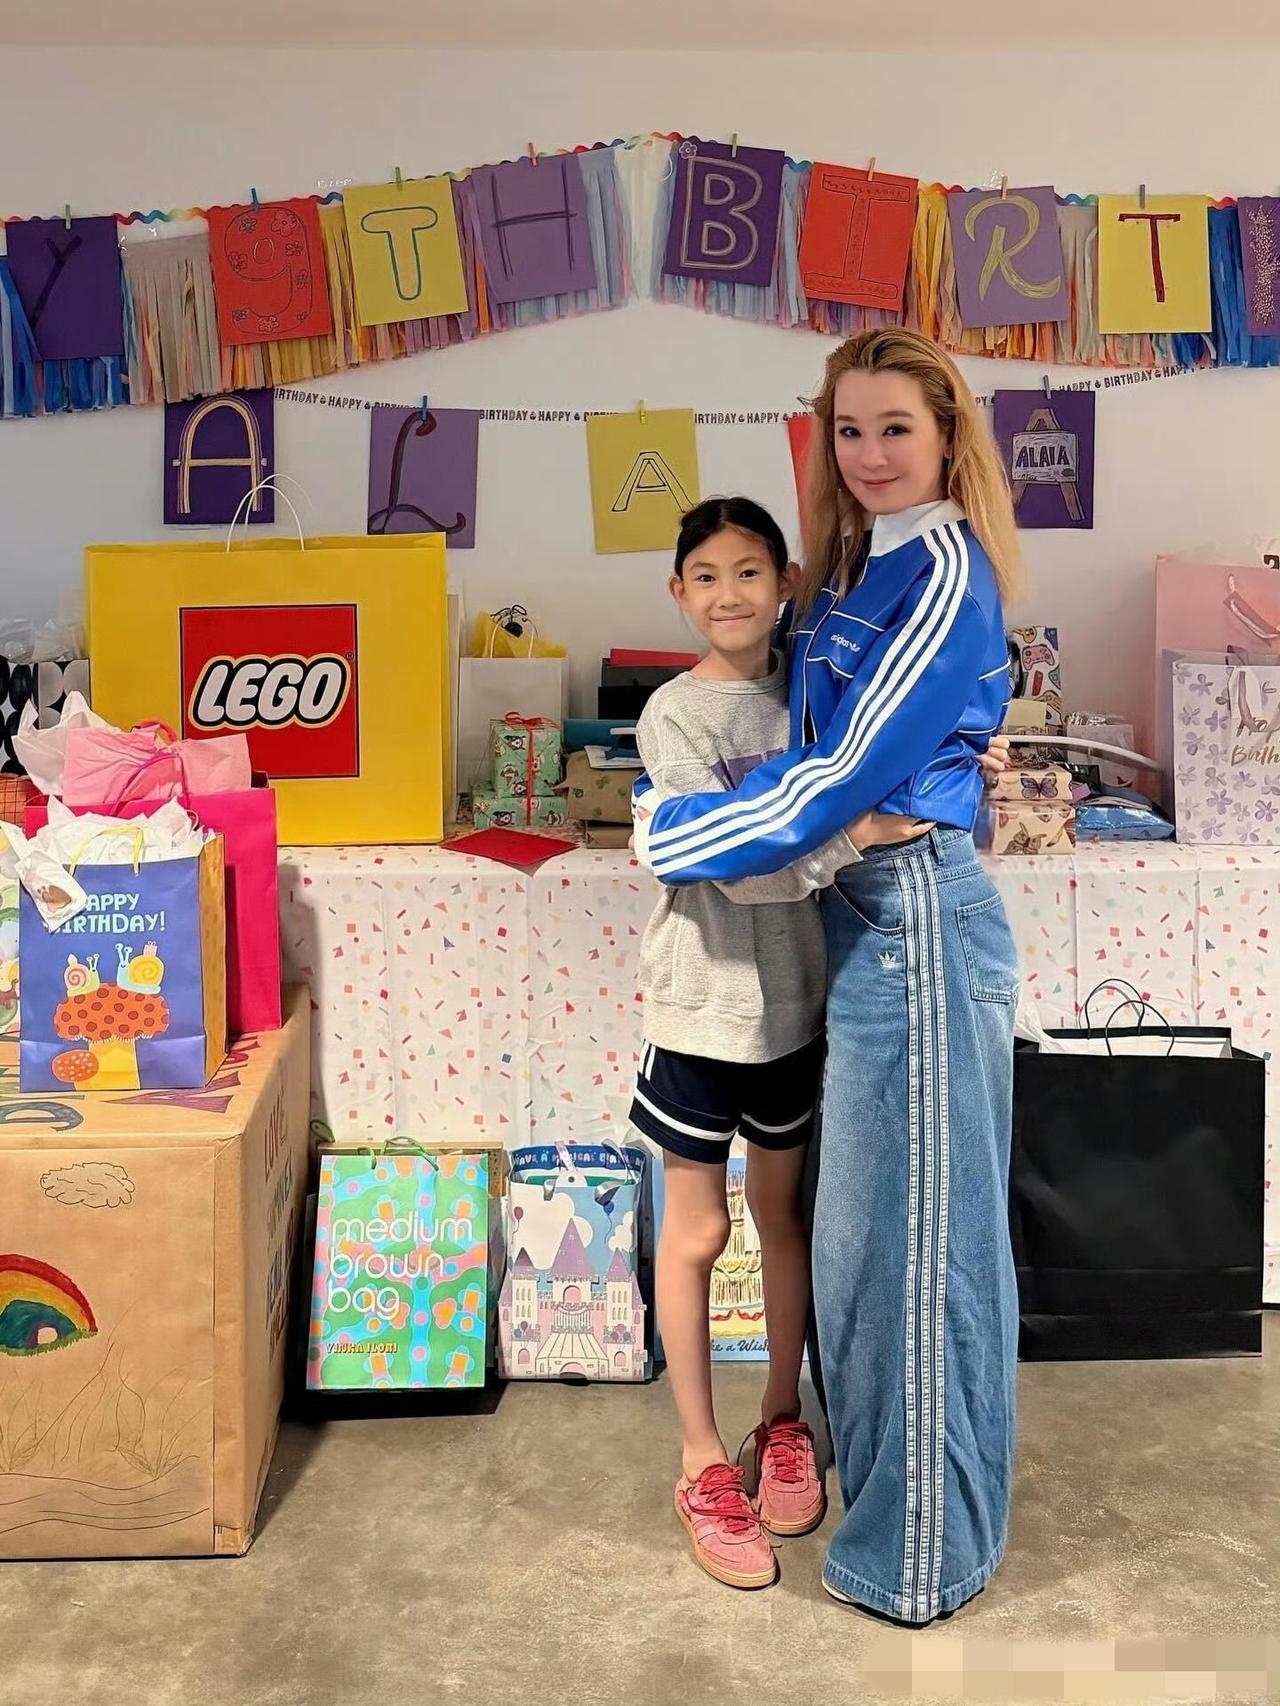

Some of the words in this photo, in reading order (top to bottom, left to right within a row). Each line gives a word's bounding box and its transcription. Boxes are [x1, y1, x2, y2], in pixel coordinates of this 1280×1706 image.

[275, 387, 319, 404] IRTHDAY
[328, 395, 362, 410] HAPPY
[480, 409, 528, 421] BIRTHDAY
[538, 411, 571, 422] HAPPY
[694, 412, 737, 424] IRTHDAY
[747, 412, 780, 424] HAPPY
[1104, 369, 1153, 388] BIRTHDAY
[192, 656, 349, 728] LEGO
[85, 893, 140, 912] APPY
[46, 911, 166, 934] IRTHDAY!
[332, 1211, 473, 1242] medium
[330, 1247, 444, 1279] brown
[328, 1279, 400, 1321] bag
